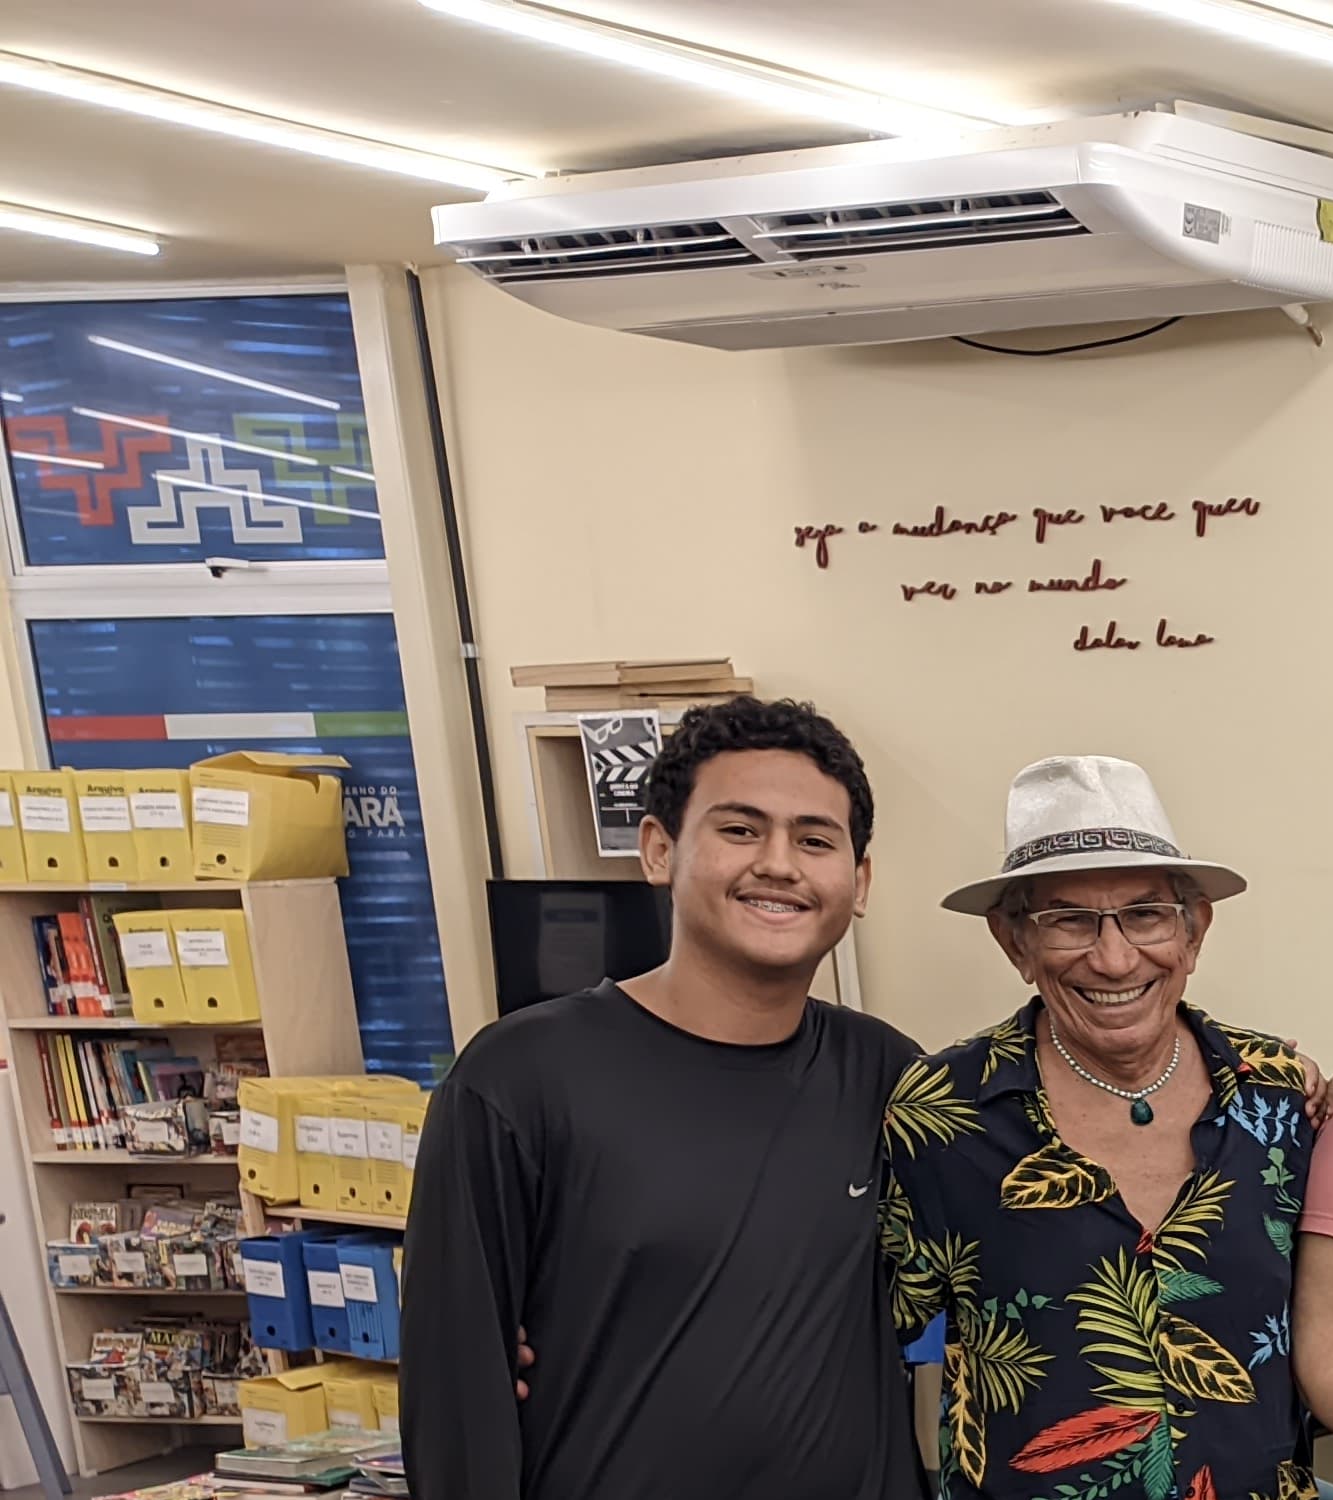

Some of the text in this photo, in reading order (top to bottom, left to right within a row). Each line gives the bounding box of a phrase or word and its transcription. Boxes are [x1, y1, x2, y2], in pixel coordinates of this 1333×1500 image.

[859, 521, 877, 534] a
[892, 506, 1017, 538] mudança
[1033, 507, 1084, 543] que
[1193, 498, 1260, 537] quer
[901, 559, 1127, 601] ver no mundo
[1156, 619, 1214, 648] lama
[380, 785, 397, 796] DO
[343, 795, 405, 828] ARÁ
